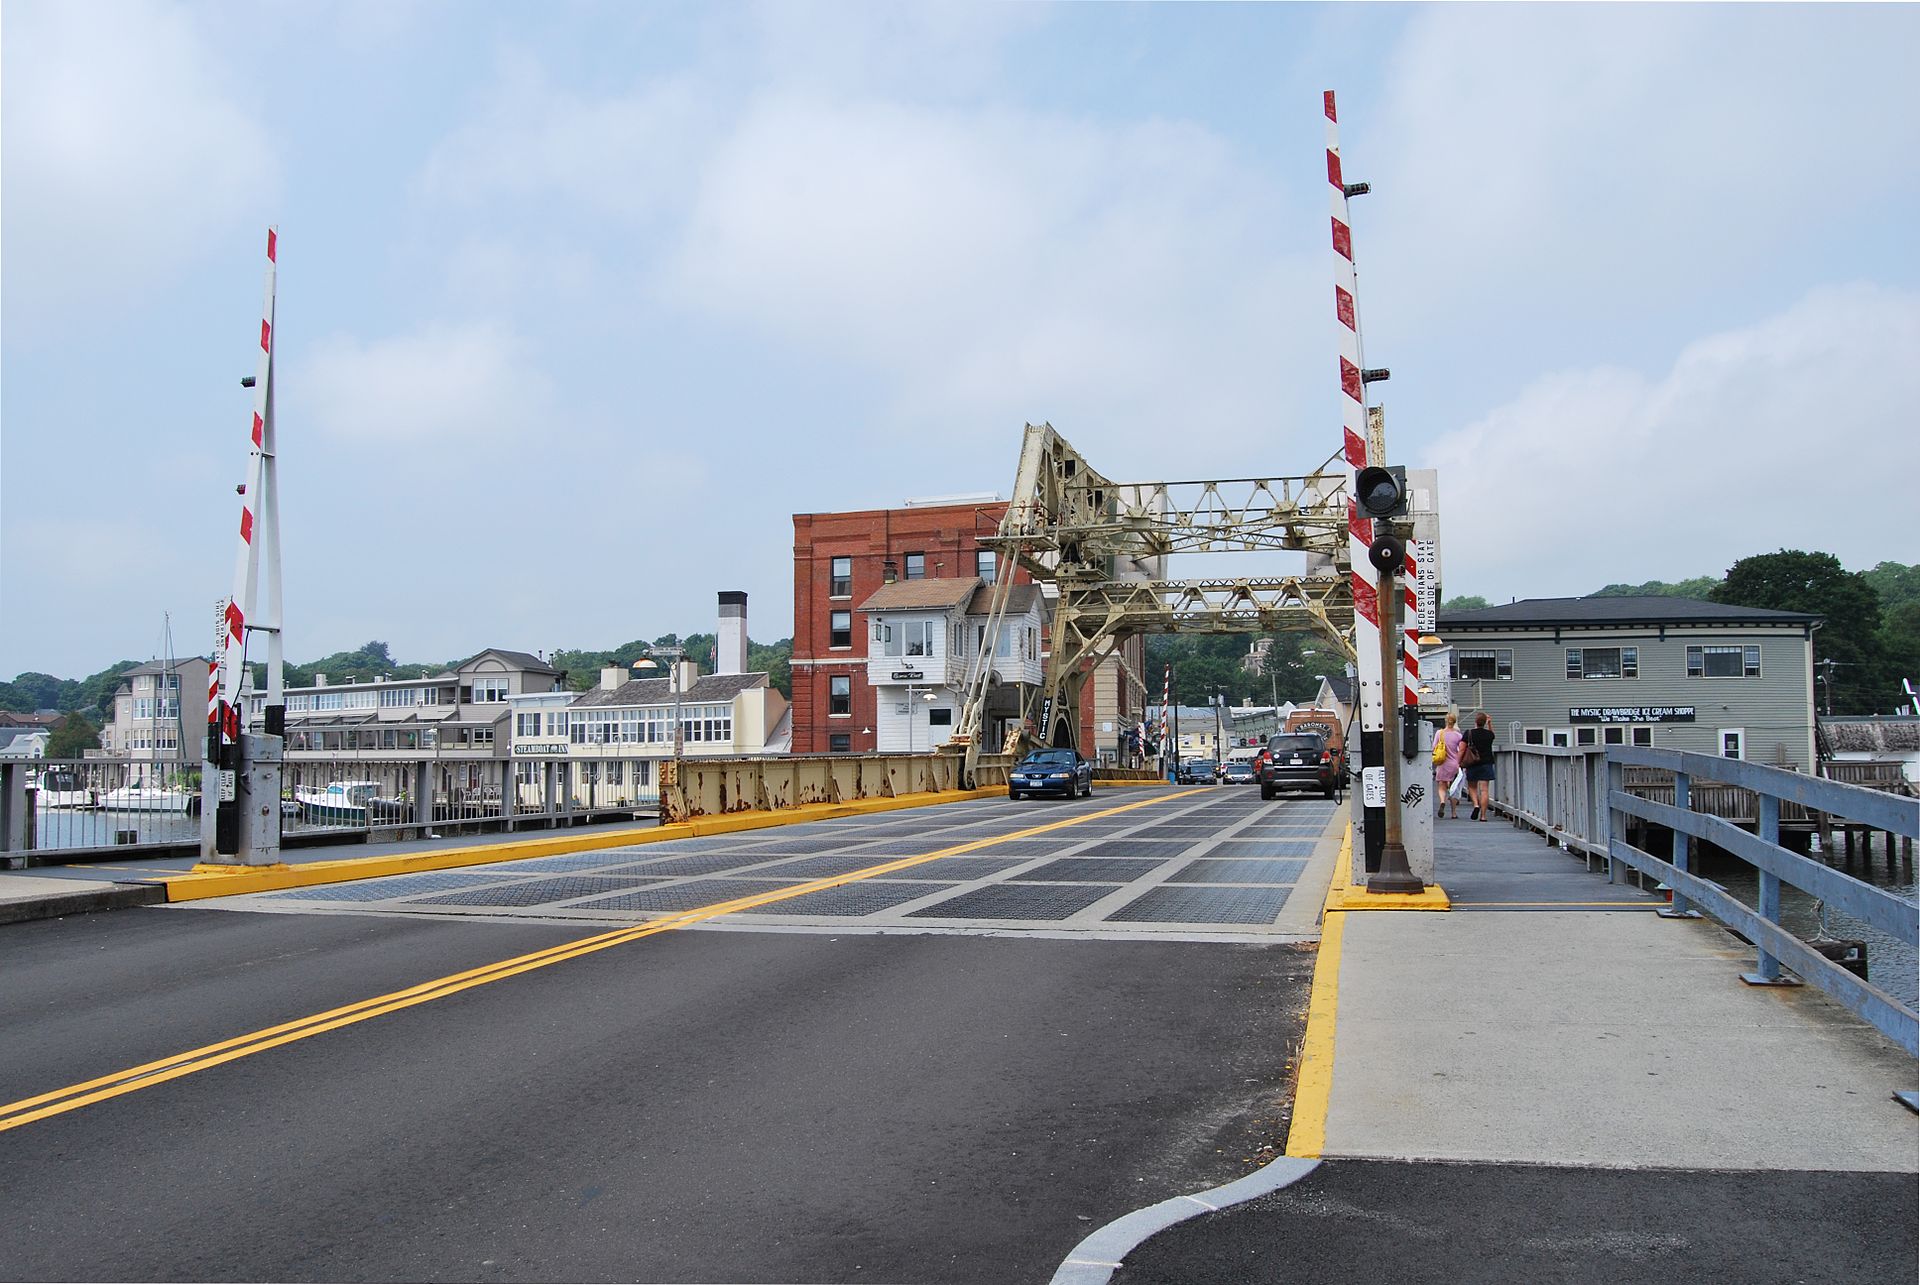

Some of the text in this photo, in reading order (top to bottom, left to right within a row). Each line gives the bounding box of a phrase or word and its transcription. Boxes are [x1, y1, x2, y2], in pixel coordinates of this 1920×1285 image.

[1426, 540, 1434, 562] GATE
[1427, 570, 1434, 580] OF
[1418, 540, 1426, 630] PEDESTRIANS STAY
[1040, 700, 1050, 739] MYSTIC
[516, 745, 550, 753] STEAMBOAT
[1366, 784, 1374, 800] GATES
